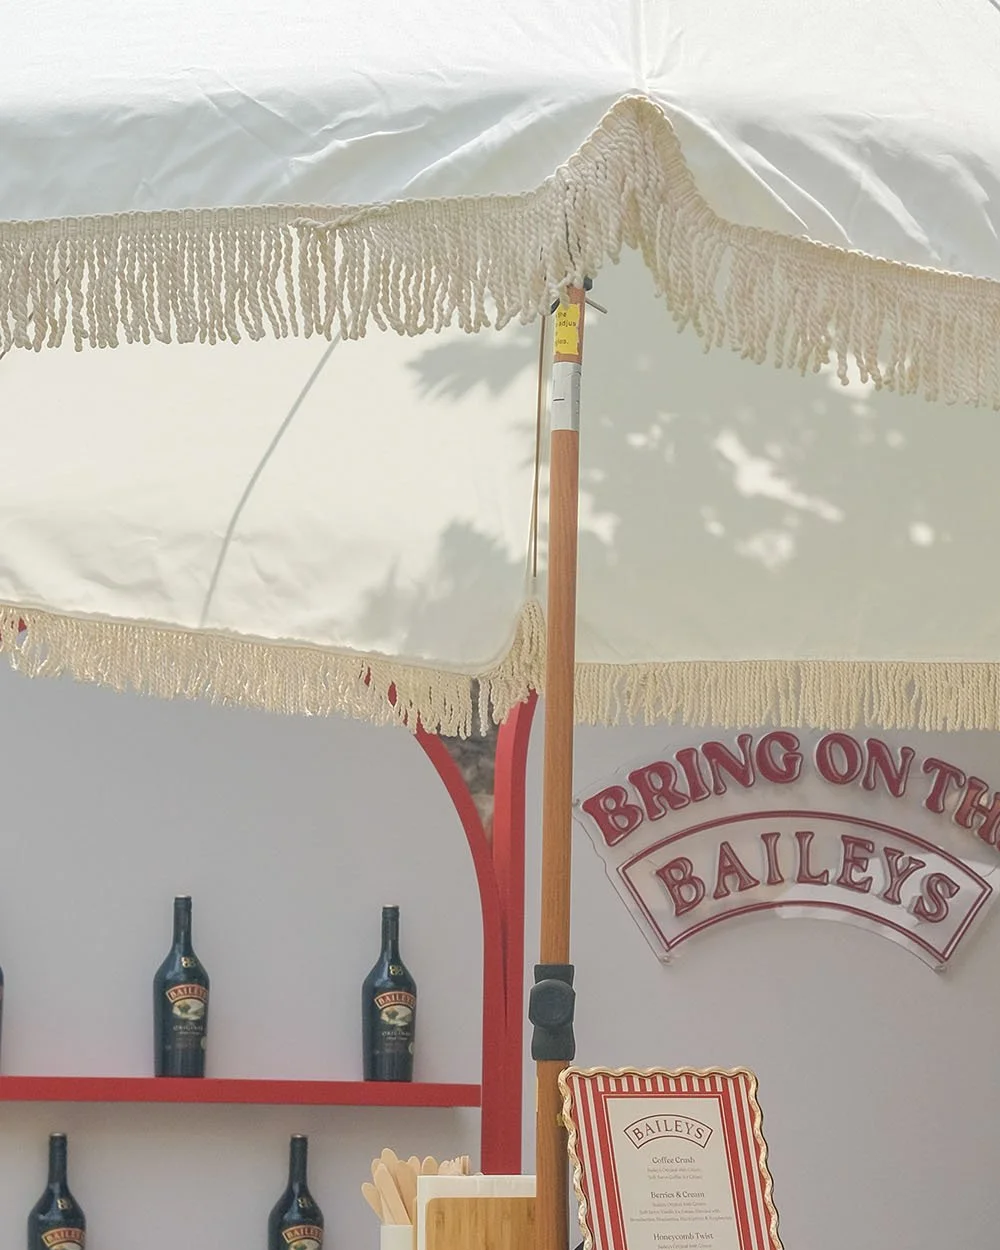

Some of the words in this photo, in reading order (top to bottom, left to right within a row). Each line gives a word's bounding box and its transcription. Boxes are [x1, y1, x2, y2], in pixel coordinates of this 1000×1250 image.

[581, 731, 802, 847] BRING
[815, 732, 915, 797] ON
[655, 831, 960, 923] BAILEYS
[632, 1119, 705, 1141] BAILEYS
[651, 1156, 675, 1164] Coffee
[650, 1191, 675, 1199] Berries
[675, 1191, 682, 1199] &
[653, 1232, 694, 1241] Honeycomb
[695, 1232, 714, 1240] Twist
